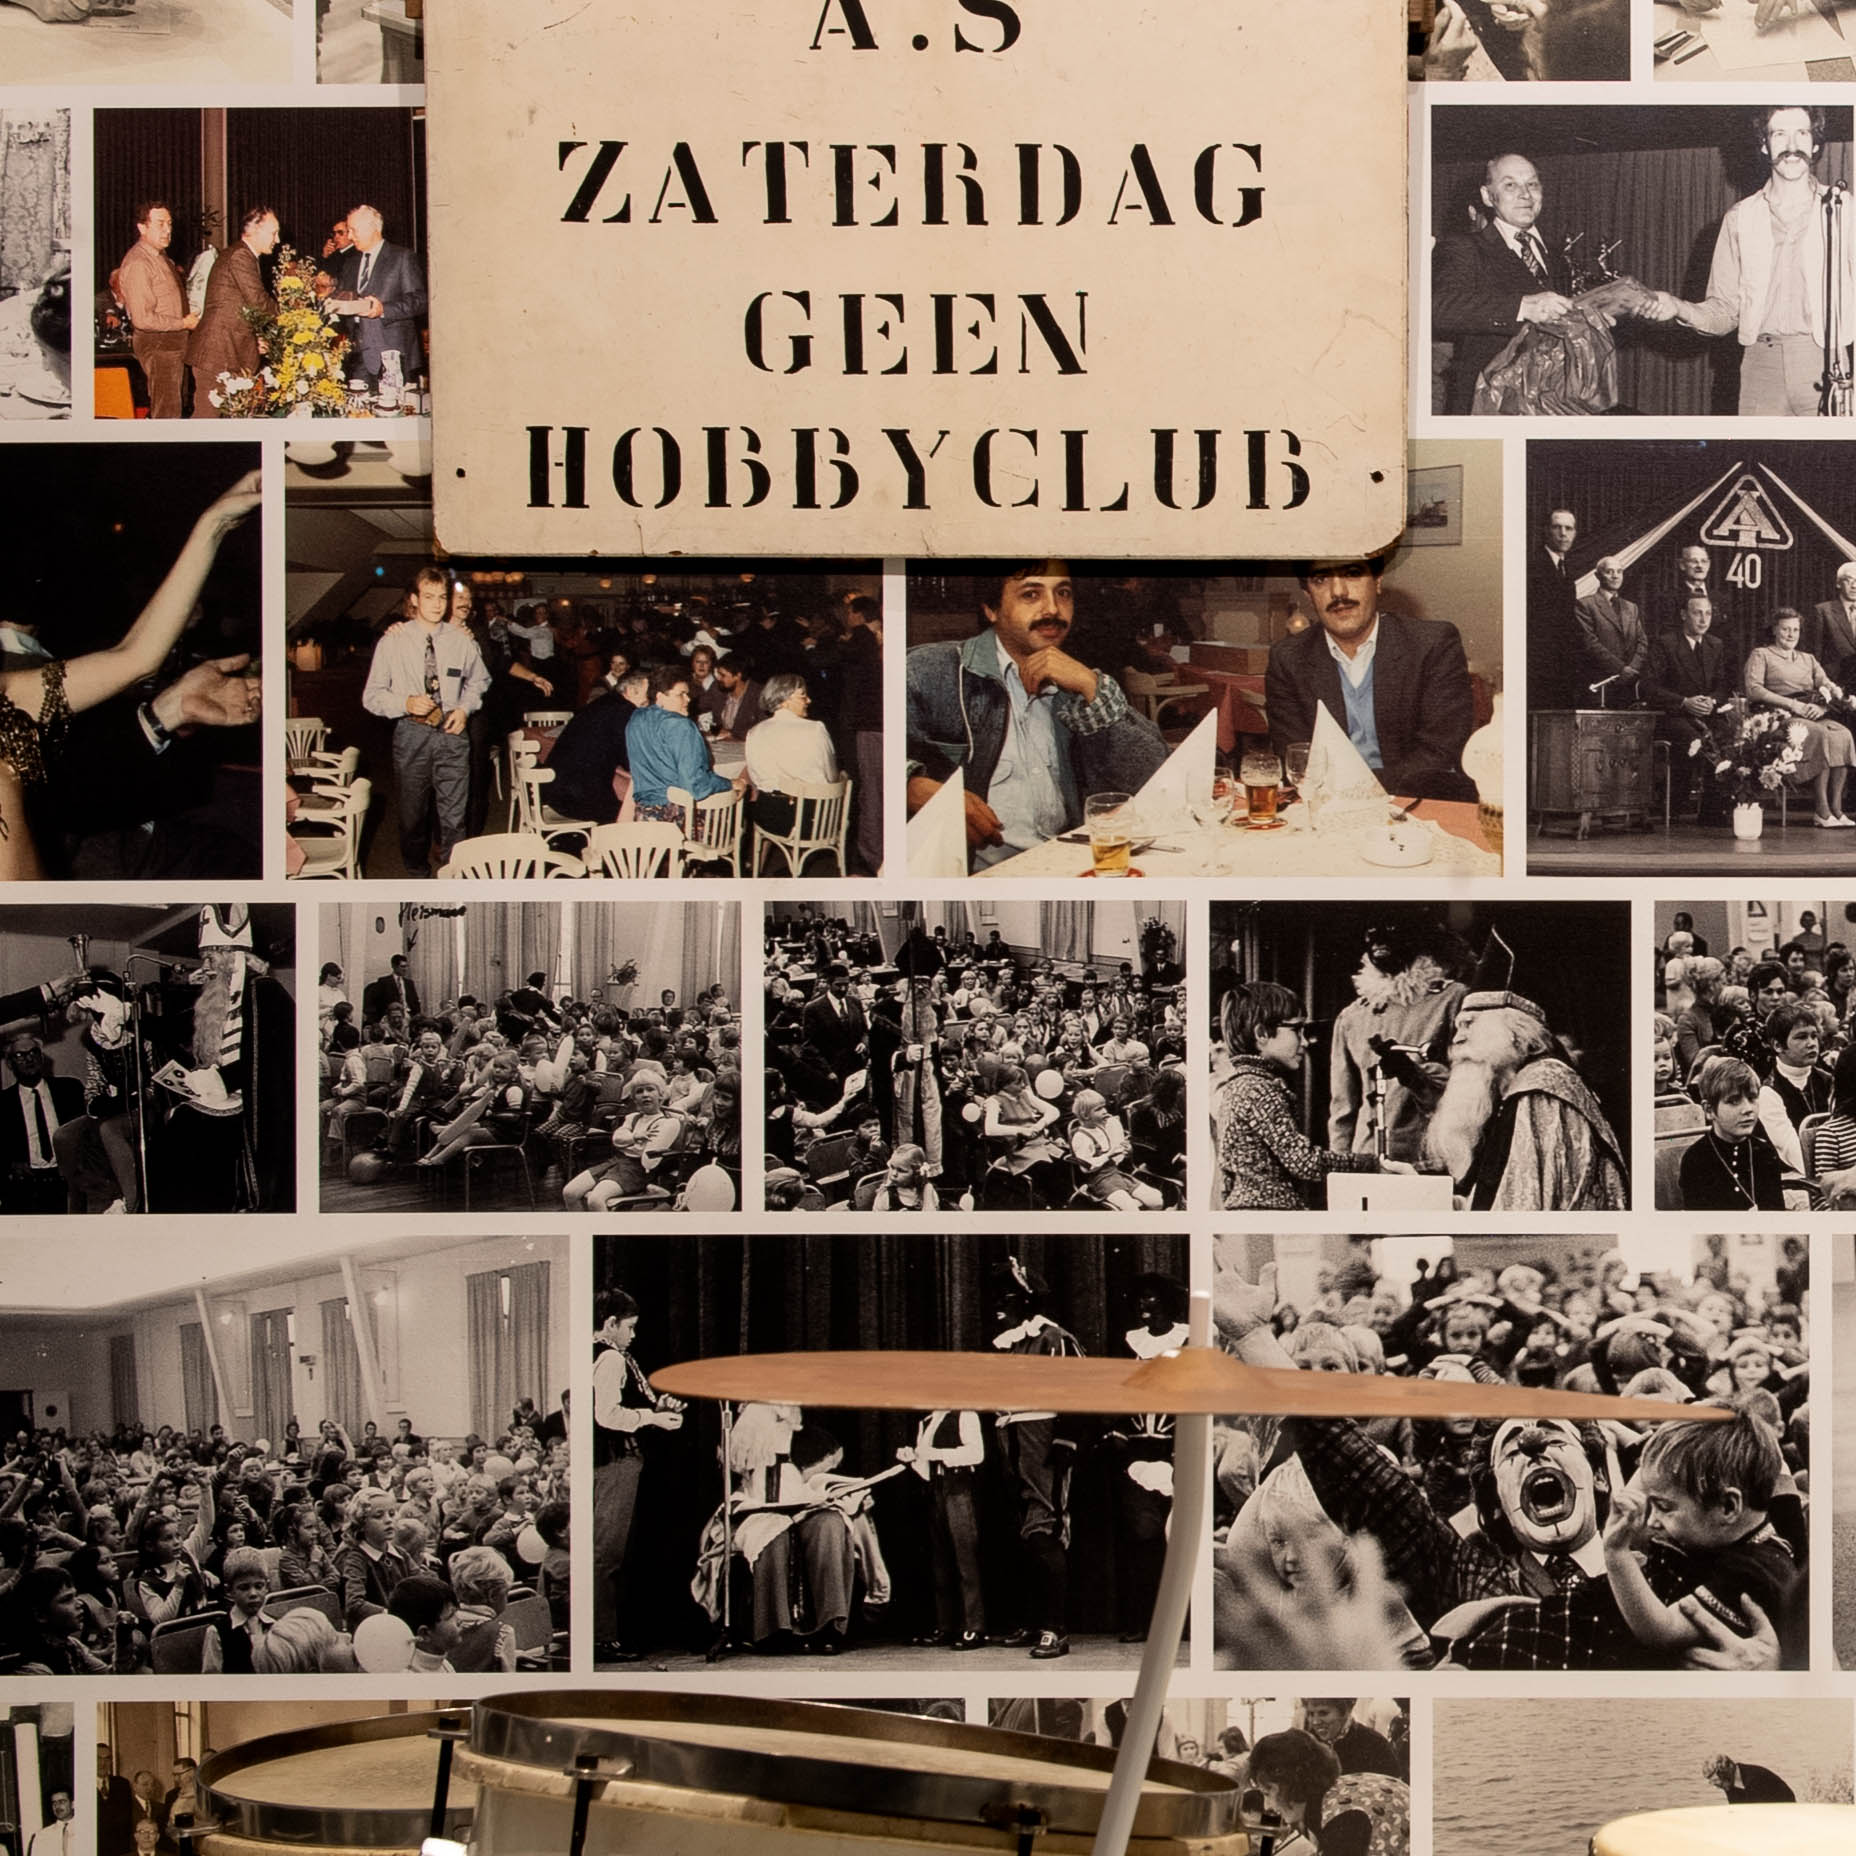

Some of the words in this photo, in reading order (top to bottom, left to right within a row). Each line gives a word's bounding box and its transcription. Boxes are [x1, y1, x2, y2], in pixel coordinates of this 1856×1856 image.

[556, 140, 1267, 228] ZATERDAG
[744, 289, 1089, 375] GEEN
[524, 425, 1313, 512] HOBBYCLUB
[1725, 552, 1762, 589] 40
